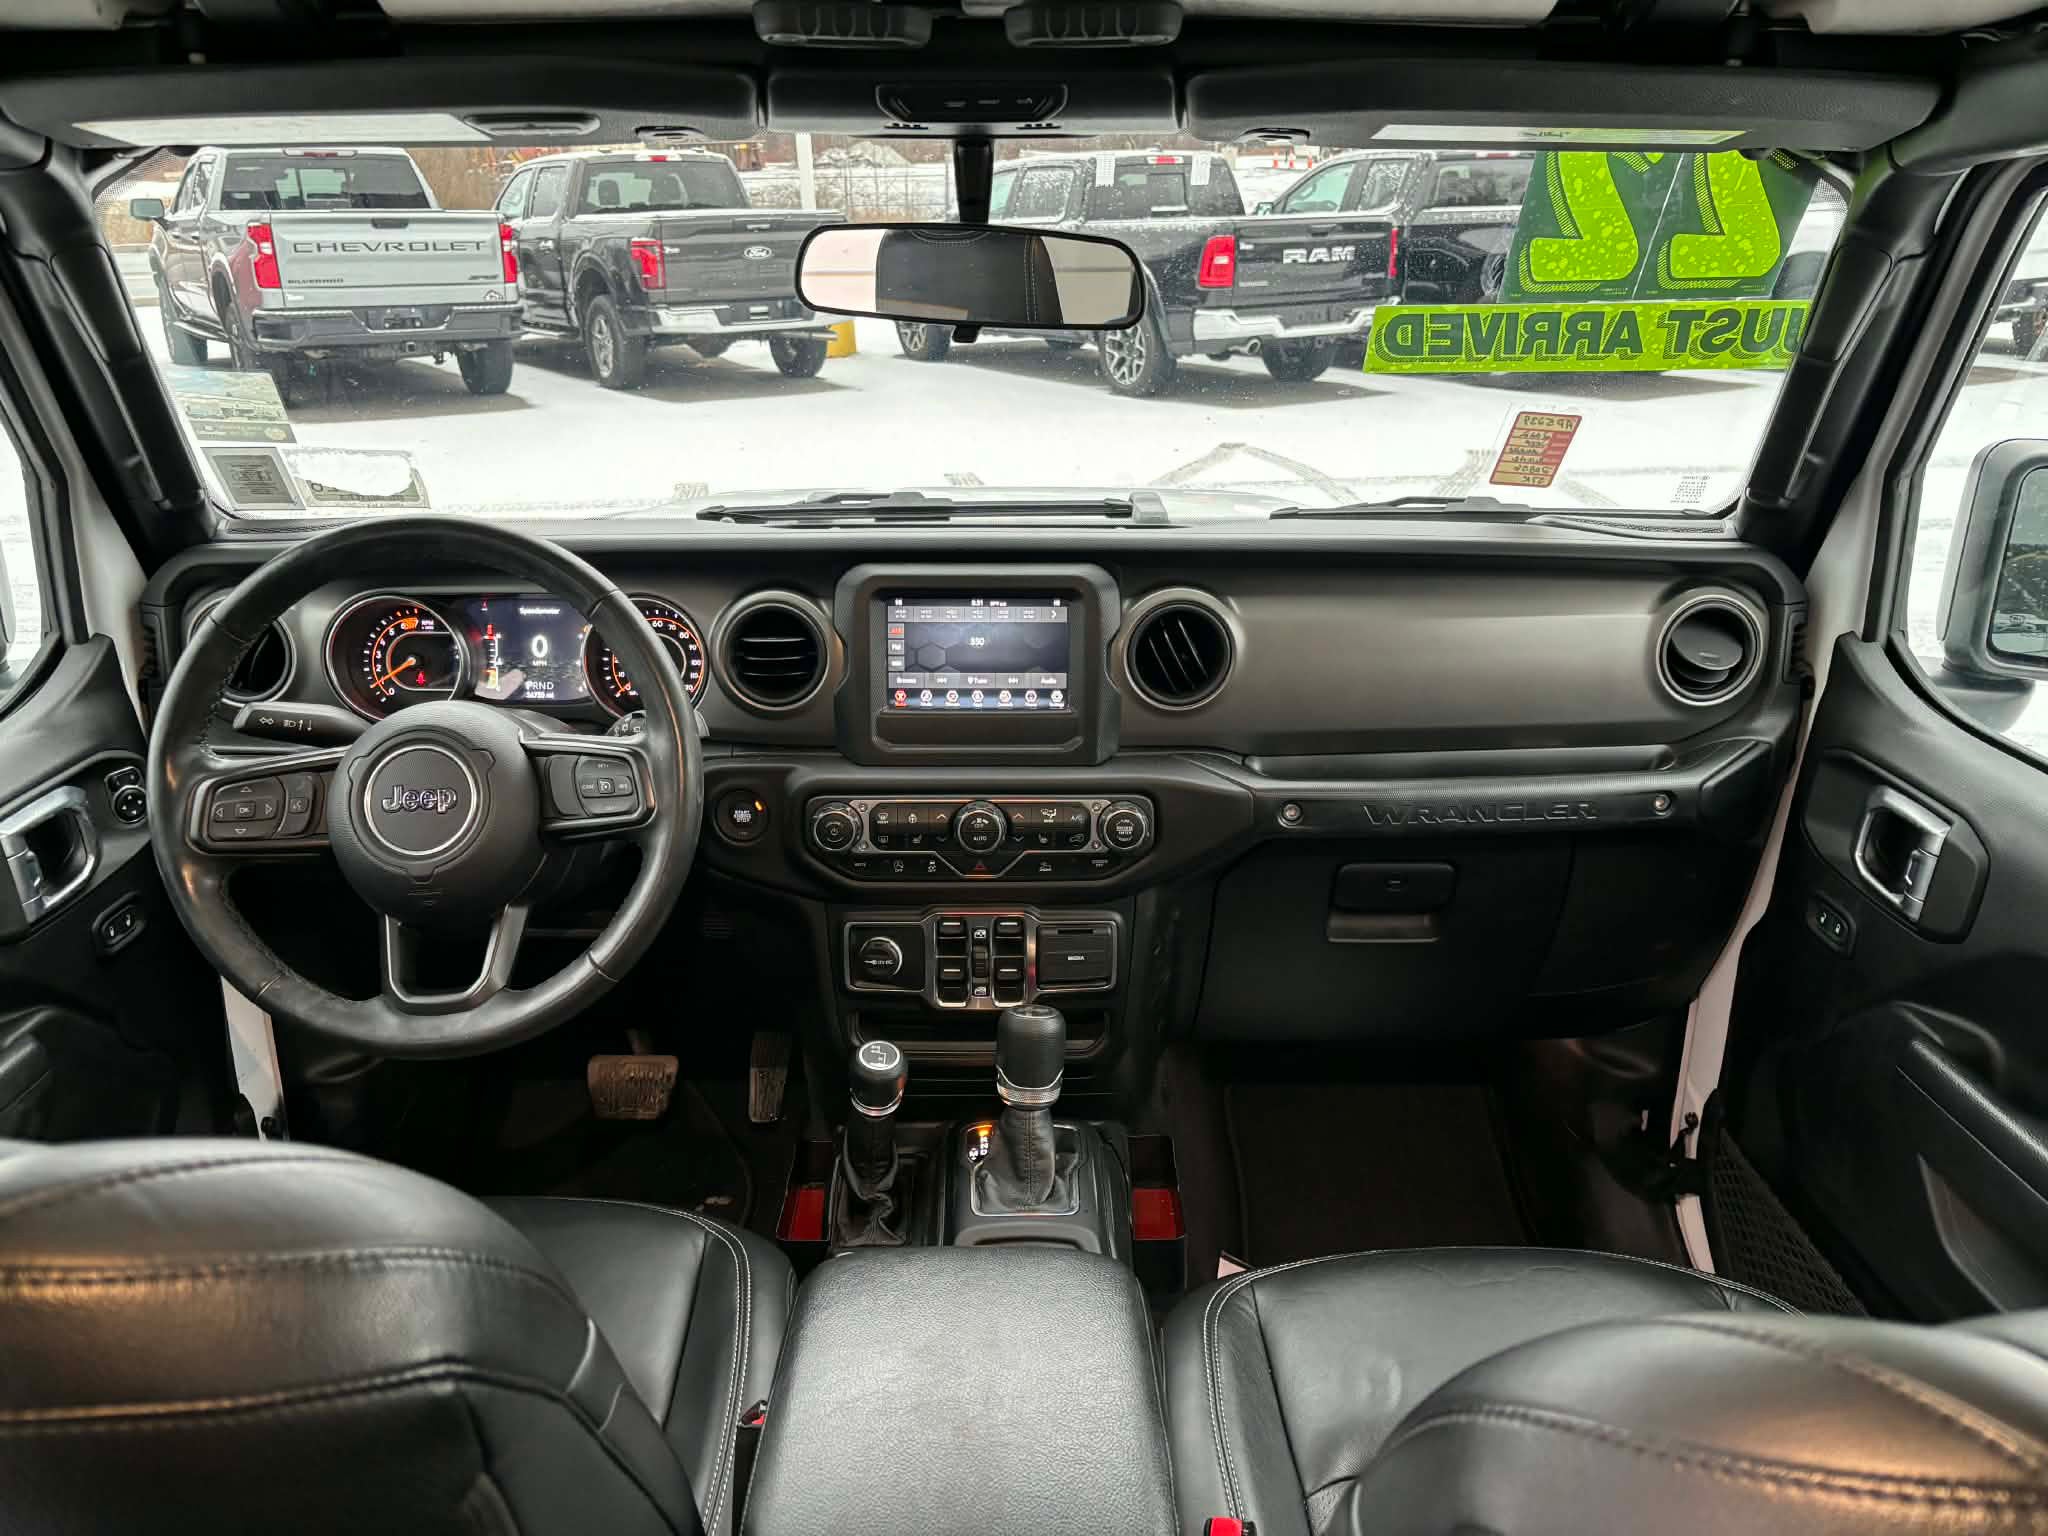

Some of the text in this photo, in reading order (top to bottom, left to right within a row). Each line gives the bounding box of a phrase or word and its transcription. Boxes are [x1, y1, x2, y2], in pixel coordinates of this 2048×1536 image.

[293, 241, 486, 253] CHEVROLET
[1283, 245, 1355, 264] RAM
[652, 620, 663, 628] 60
[531, 635, 548, 658] 0
[381, 785, 457, 814] Jeep
[1363, 803, 1599, 825] WRANGLER
